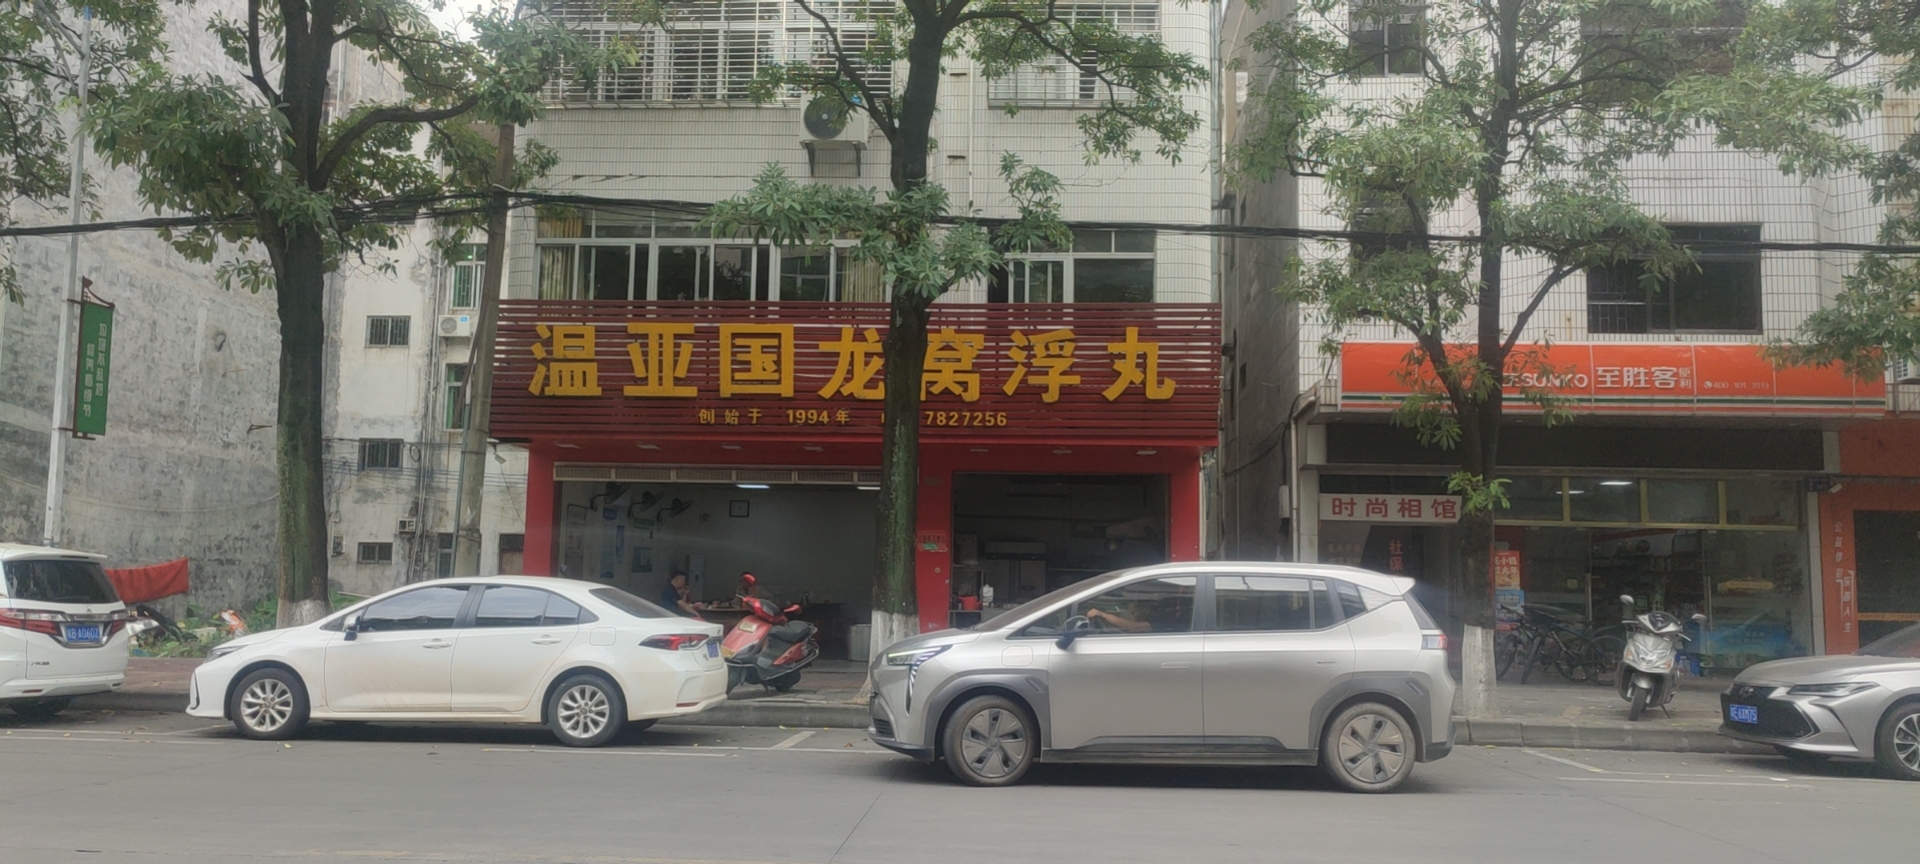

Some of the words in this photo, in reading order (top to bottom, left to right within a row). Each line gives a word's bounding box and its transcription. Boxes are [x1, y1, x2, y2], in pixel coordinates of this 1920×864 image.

[529, 322, 1176, 402] 温亚国龙窝浮丸
[1596, 366, 1678, 388] 至胜客
[1679, 367, 1692, 389] 便利
[698, 408, 763, 425] 创始于
[924, 411, 1007, 426] 7827256
[1331, 497, 1457, 519] 时尚相馆
